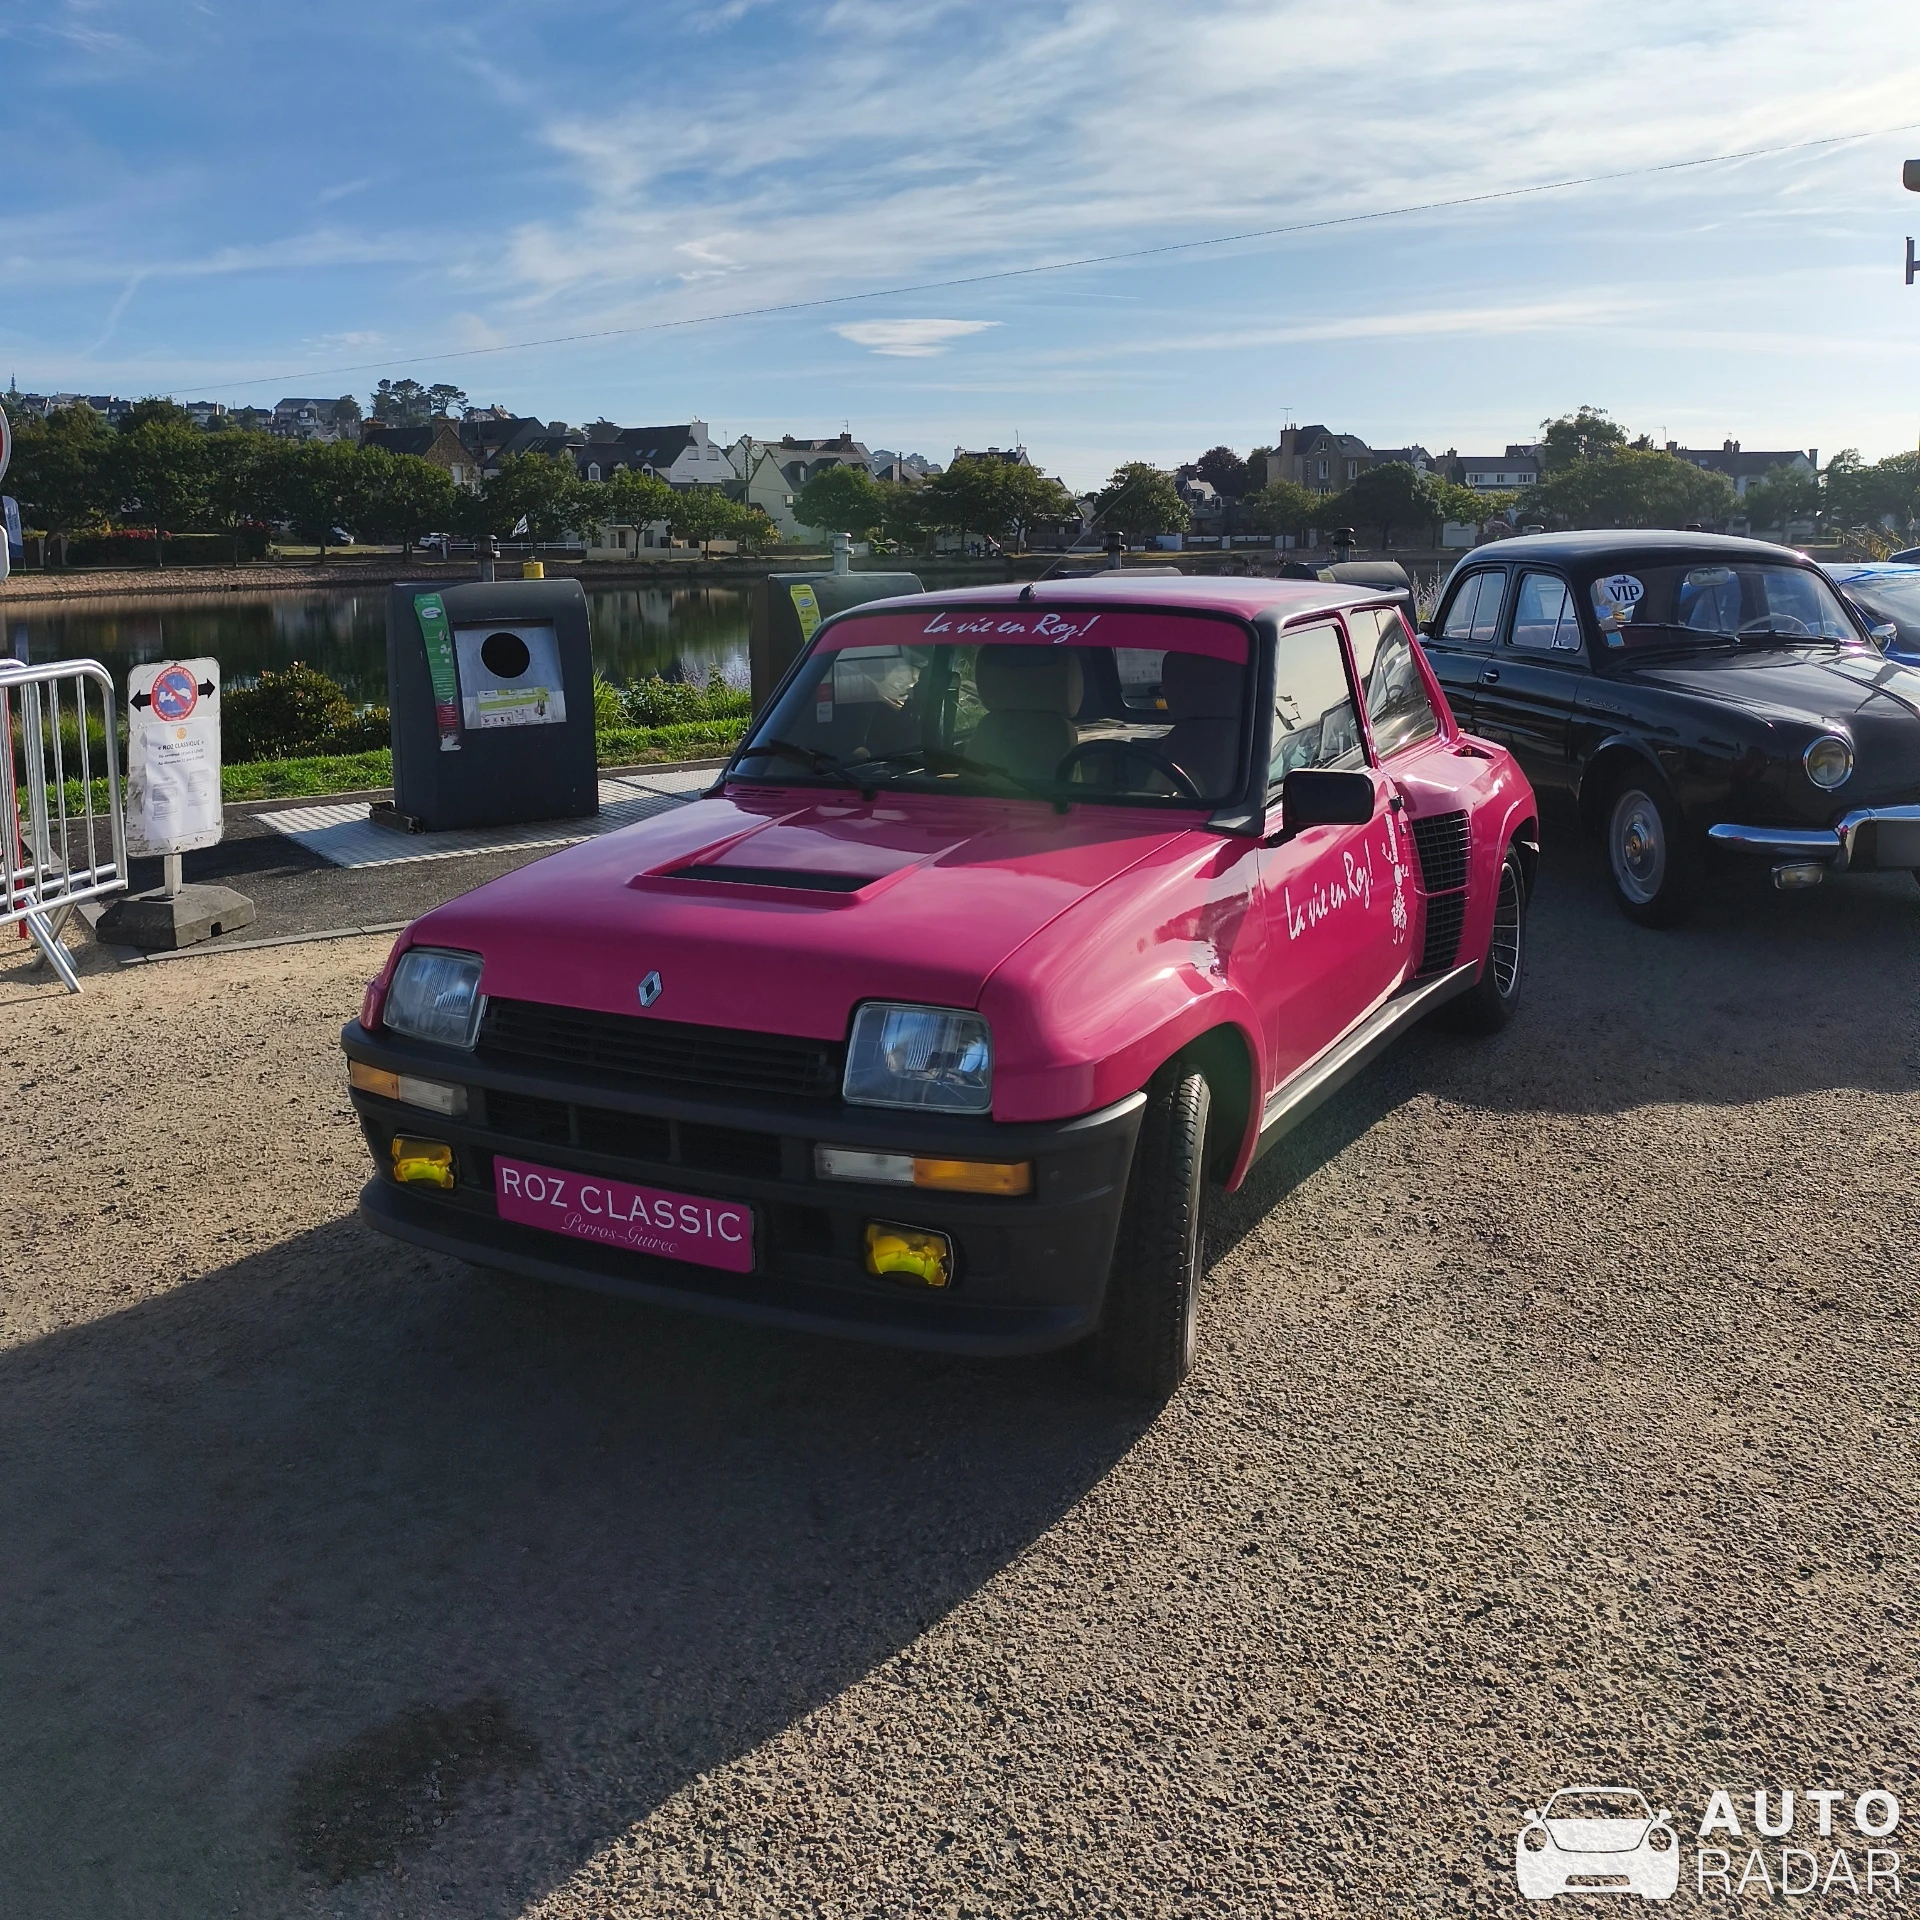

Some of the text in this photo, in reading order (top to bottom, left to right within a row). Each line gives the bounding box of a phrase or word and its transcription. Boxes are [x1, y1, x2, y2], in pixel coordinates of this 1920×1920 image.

[1608, 585, 1640, 602] VIP
[923, 611, 1101, 644] La vie en Roz!
[174, 740, 200, 749] CLASSIQUE
[1285, 838, 1374, 940] La vie en Roz!
[502, 1167, 743, 1242] ROZ CLASSIC
[561, 1211, 679, 1253] Perros-Guirec
